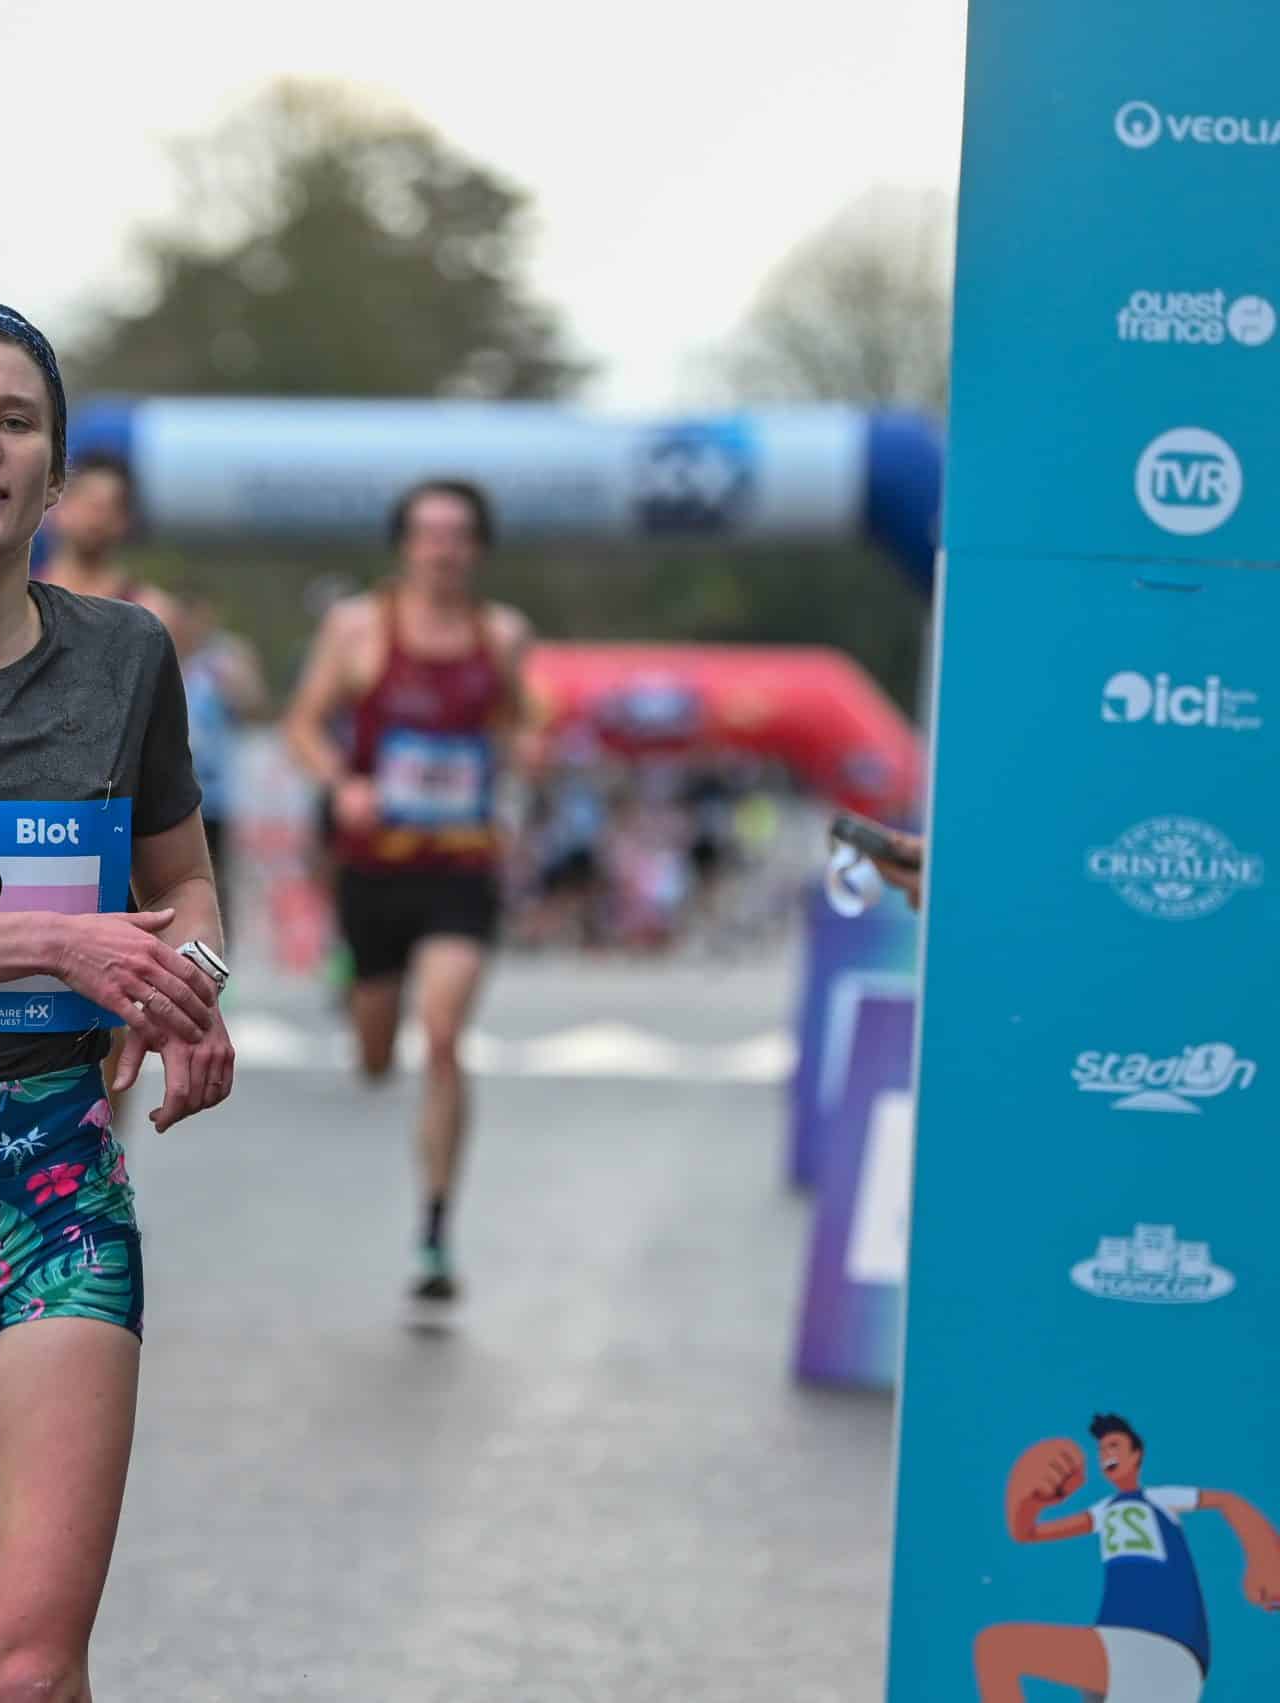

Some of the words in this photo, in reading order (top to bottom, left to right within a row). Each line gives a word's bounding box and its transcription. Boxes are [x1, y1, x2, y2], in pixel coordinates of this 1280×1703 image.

[1130, 288, 1225, 320] ouest
[1117, 306, 1224, 344] france
[1151, 459, 1226, 500] TVR
[1154, 672, 1220, 727] ici
[16, 818, 79, 844] Blot
[1089, 851, 1260, 882] CRISTALINE
